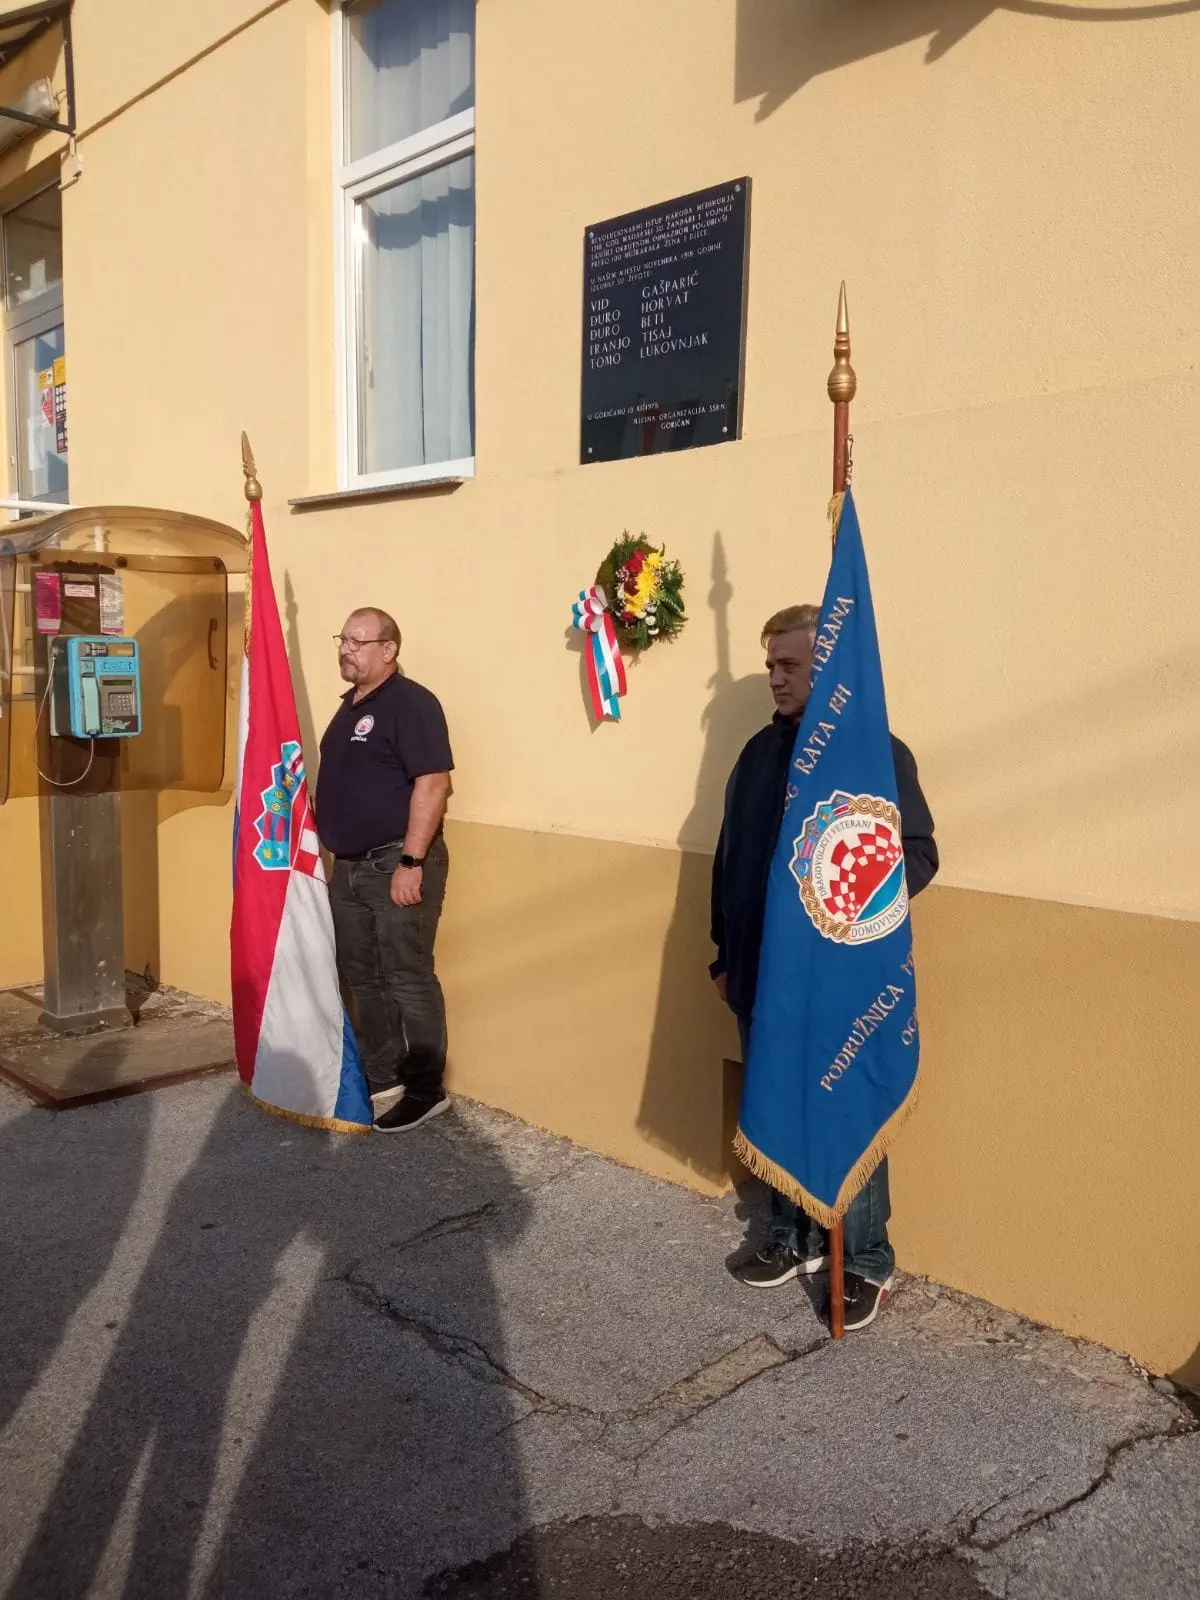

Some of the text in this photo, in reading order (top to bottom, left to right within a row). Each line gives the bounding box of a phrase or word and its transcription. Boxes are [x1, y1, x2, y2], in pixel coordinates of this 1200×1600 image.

[591, 223, 643, 244] REVOLUCIONARNI
[645, 216, 663, 229] ISTUP
[665, 207, 693, 222] NARODA
[652, 226, 689, 243] ODMAZDOM
[692, 213, 728, 231] POGUBIVŠI
[656, 224, 664, 233] SU
[705, 204, 733, 217] VOJNICI
[590, 277, 596, 285] U
[619, 265, 641, 277] MJESTU
[643, 255, 678, 270] NOVEMBRA
[697, 241, 722, 255] GODINE
[591, 258, 610, 269] PREKO
[624, 243, 660, 259] MUŠKARACA
[664, 236, 681, 248] ŽENA
[590, 270, 700, 313] VID GAŠPARIĆ
[617, 277, 625, 286] SU
[590, 291, 689, 328] ĐURO HORVAT
[590, 312, 664, 341] ĐURO BETI
[642, 325, 672, 344] TISAJ
[590, 331, 709, 370] TOMO LUKOVNJAK
[587, 411, 593, 421] U
[594, 407, 626, 420] GORIČANU
[633, 415, 656, 425] MJESNA
[658, 405, 706, 421] ORGANIZACIJA
[660, 418, 690, 430] GORIČAN
[794, 683, 853, 775] RATA RH
[814, 837, 833, 896] DRAGOVOLJCI
[831, 819, 872, 834] VETERANI
[820, 983, 905, 1092] PODRUŽNICA
